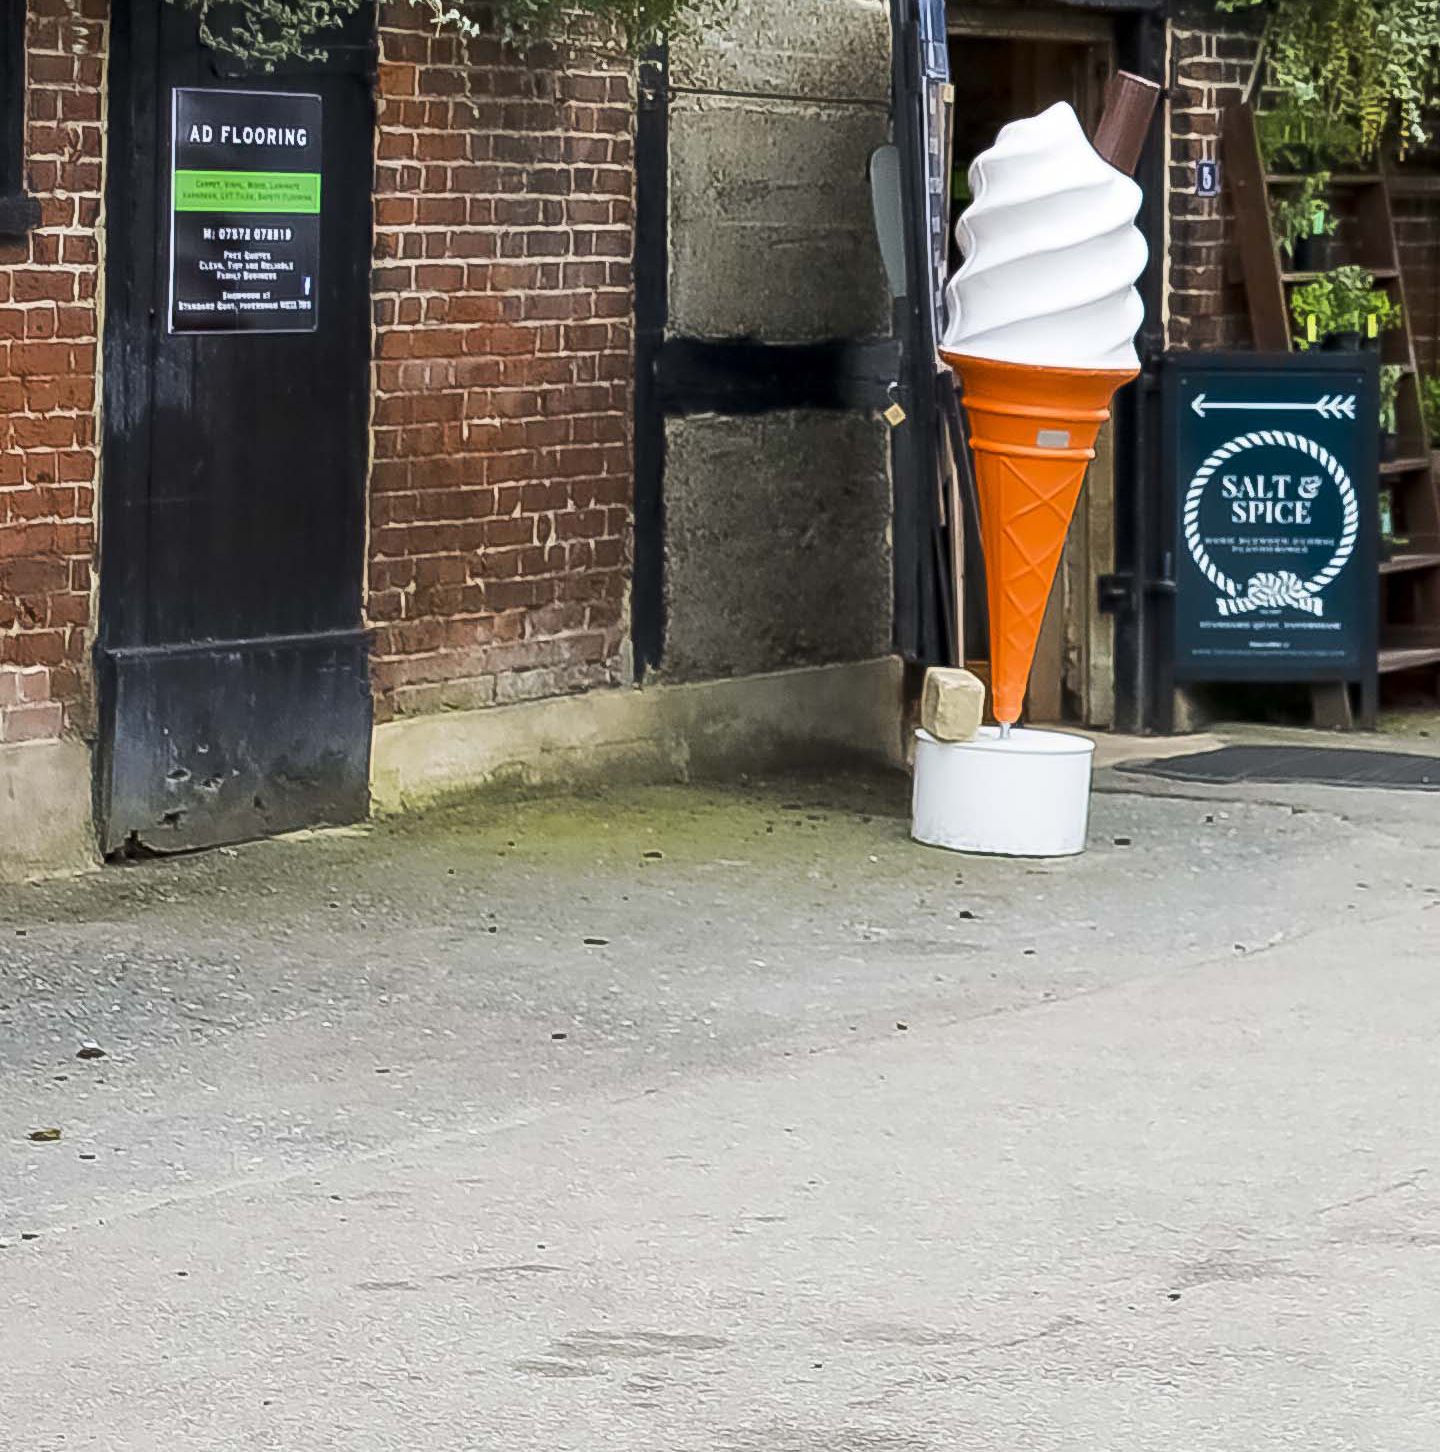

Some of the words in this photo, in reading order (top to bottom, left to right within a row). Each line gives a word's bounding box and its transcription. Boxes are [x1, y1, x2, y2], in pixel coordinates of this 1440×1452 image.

[190, 125, 212, 143] AD
[221, 125, 307, 146] FLOORING
[1221, 475, 1291, 499] SALT
[1297, 475, 1323, 499] &
[1231, 501, 1312, 524] SPICE
